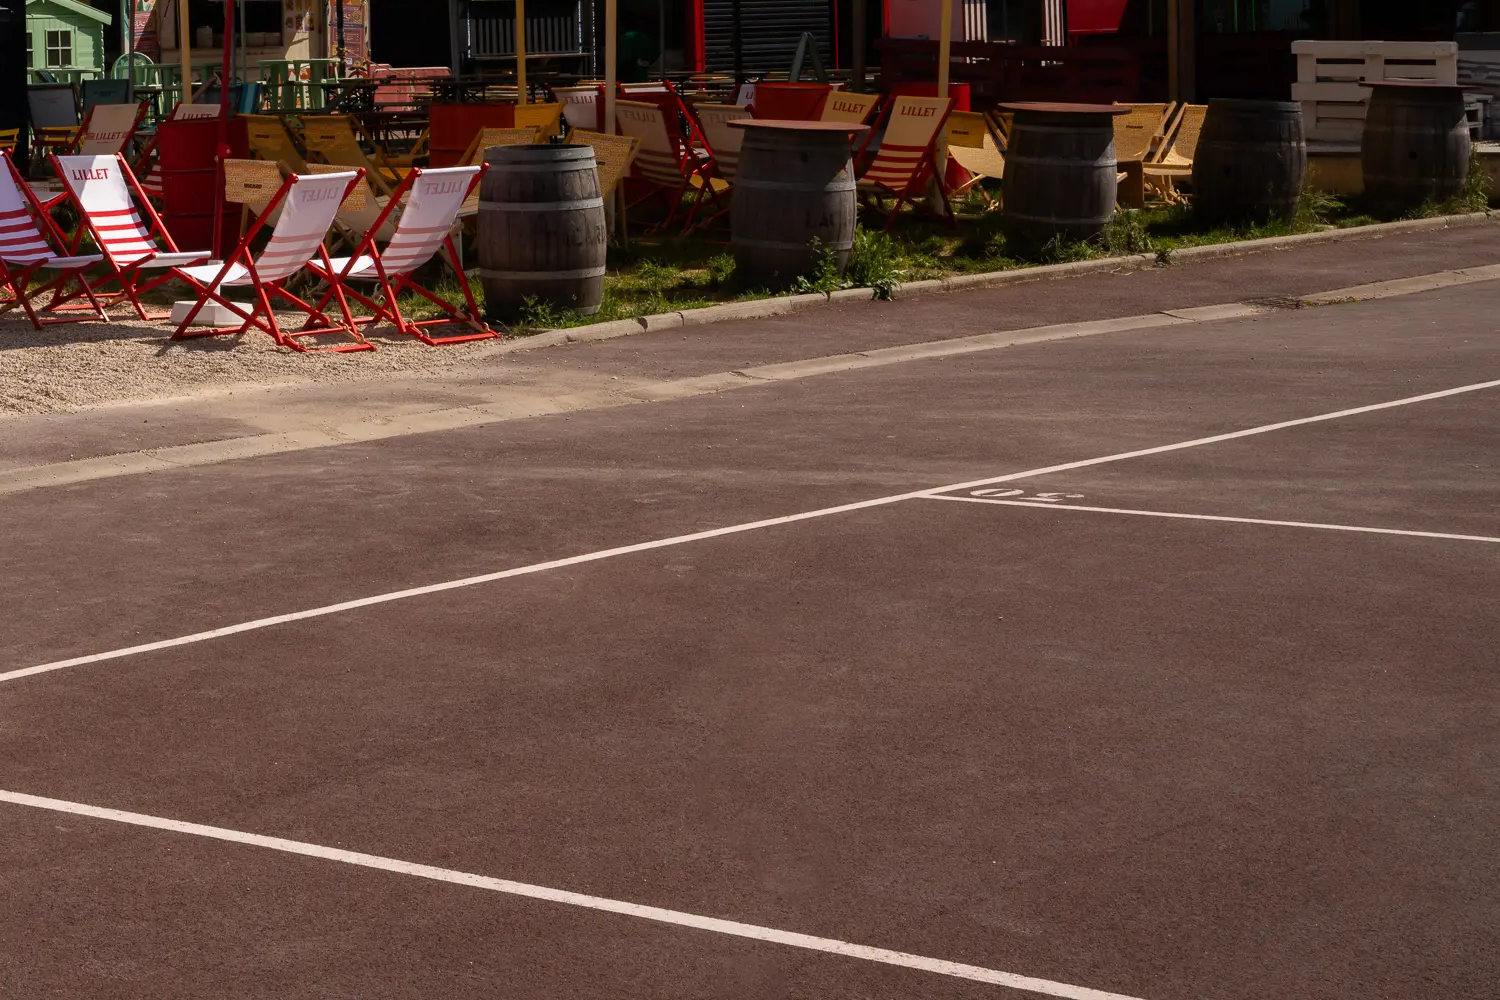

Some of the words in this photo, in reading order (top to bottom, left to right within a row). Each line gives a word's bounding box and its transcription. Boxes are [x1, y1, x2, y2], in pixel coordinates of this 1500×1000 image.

[832, 100, 867, 115] LILLET
[900, 104, 938, 117] LILLET
[94, 131, 122, 141] LILLET
[72, 167, 109, 181] LILLET
